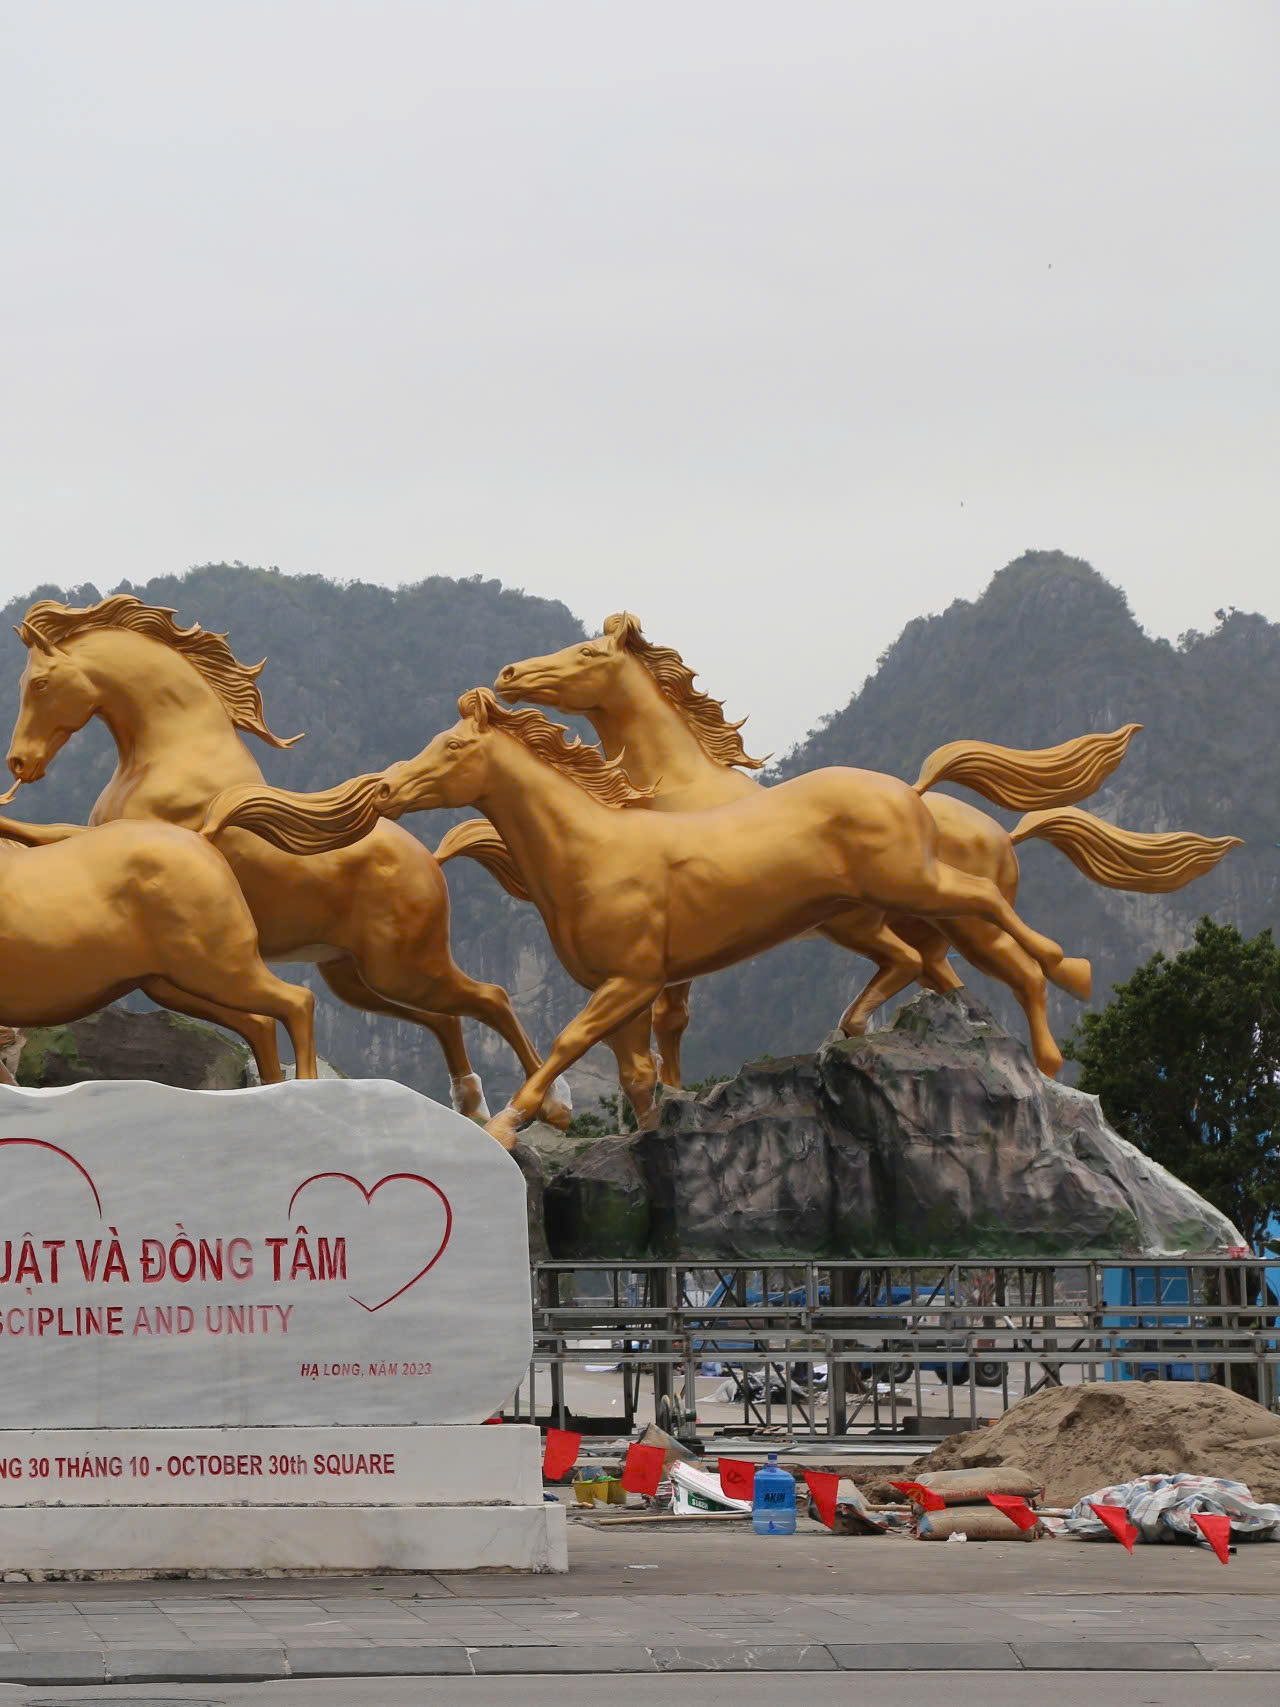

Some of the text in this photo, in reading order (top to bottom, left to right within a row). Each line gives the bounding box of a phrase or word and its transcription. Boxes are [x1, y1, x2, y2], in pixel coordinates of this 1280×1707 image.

[75, 1226, 130, 1283] VÀ
[139, 1222, 254, 1284] ĐỒNG
[265, 1225, 348, 1282] TÂM
[132, 1305, 195, 1337] AND
[205, 1303, 294, 1336] UNITY
[300, 1359, 432, 1380] HẠ LONG, NĂM 2023
[28, 1457, 50, 1479] 30
[55, 1451, 123, 1479] THÁNG
[129, 1456, 150, 1477] 10
[167, 1454, 263, 1477] OCTOBER
[268, 1454, 309, 1477] 30th
[313, 1453, 396, 1477] SQUARE
